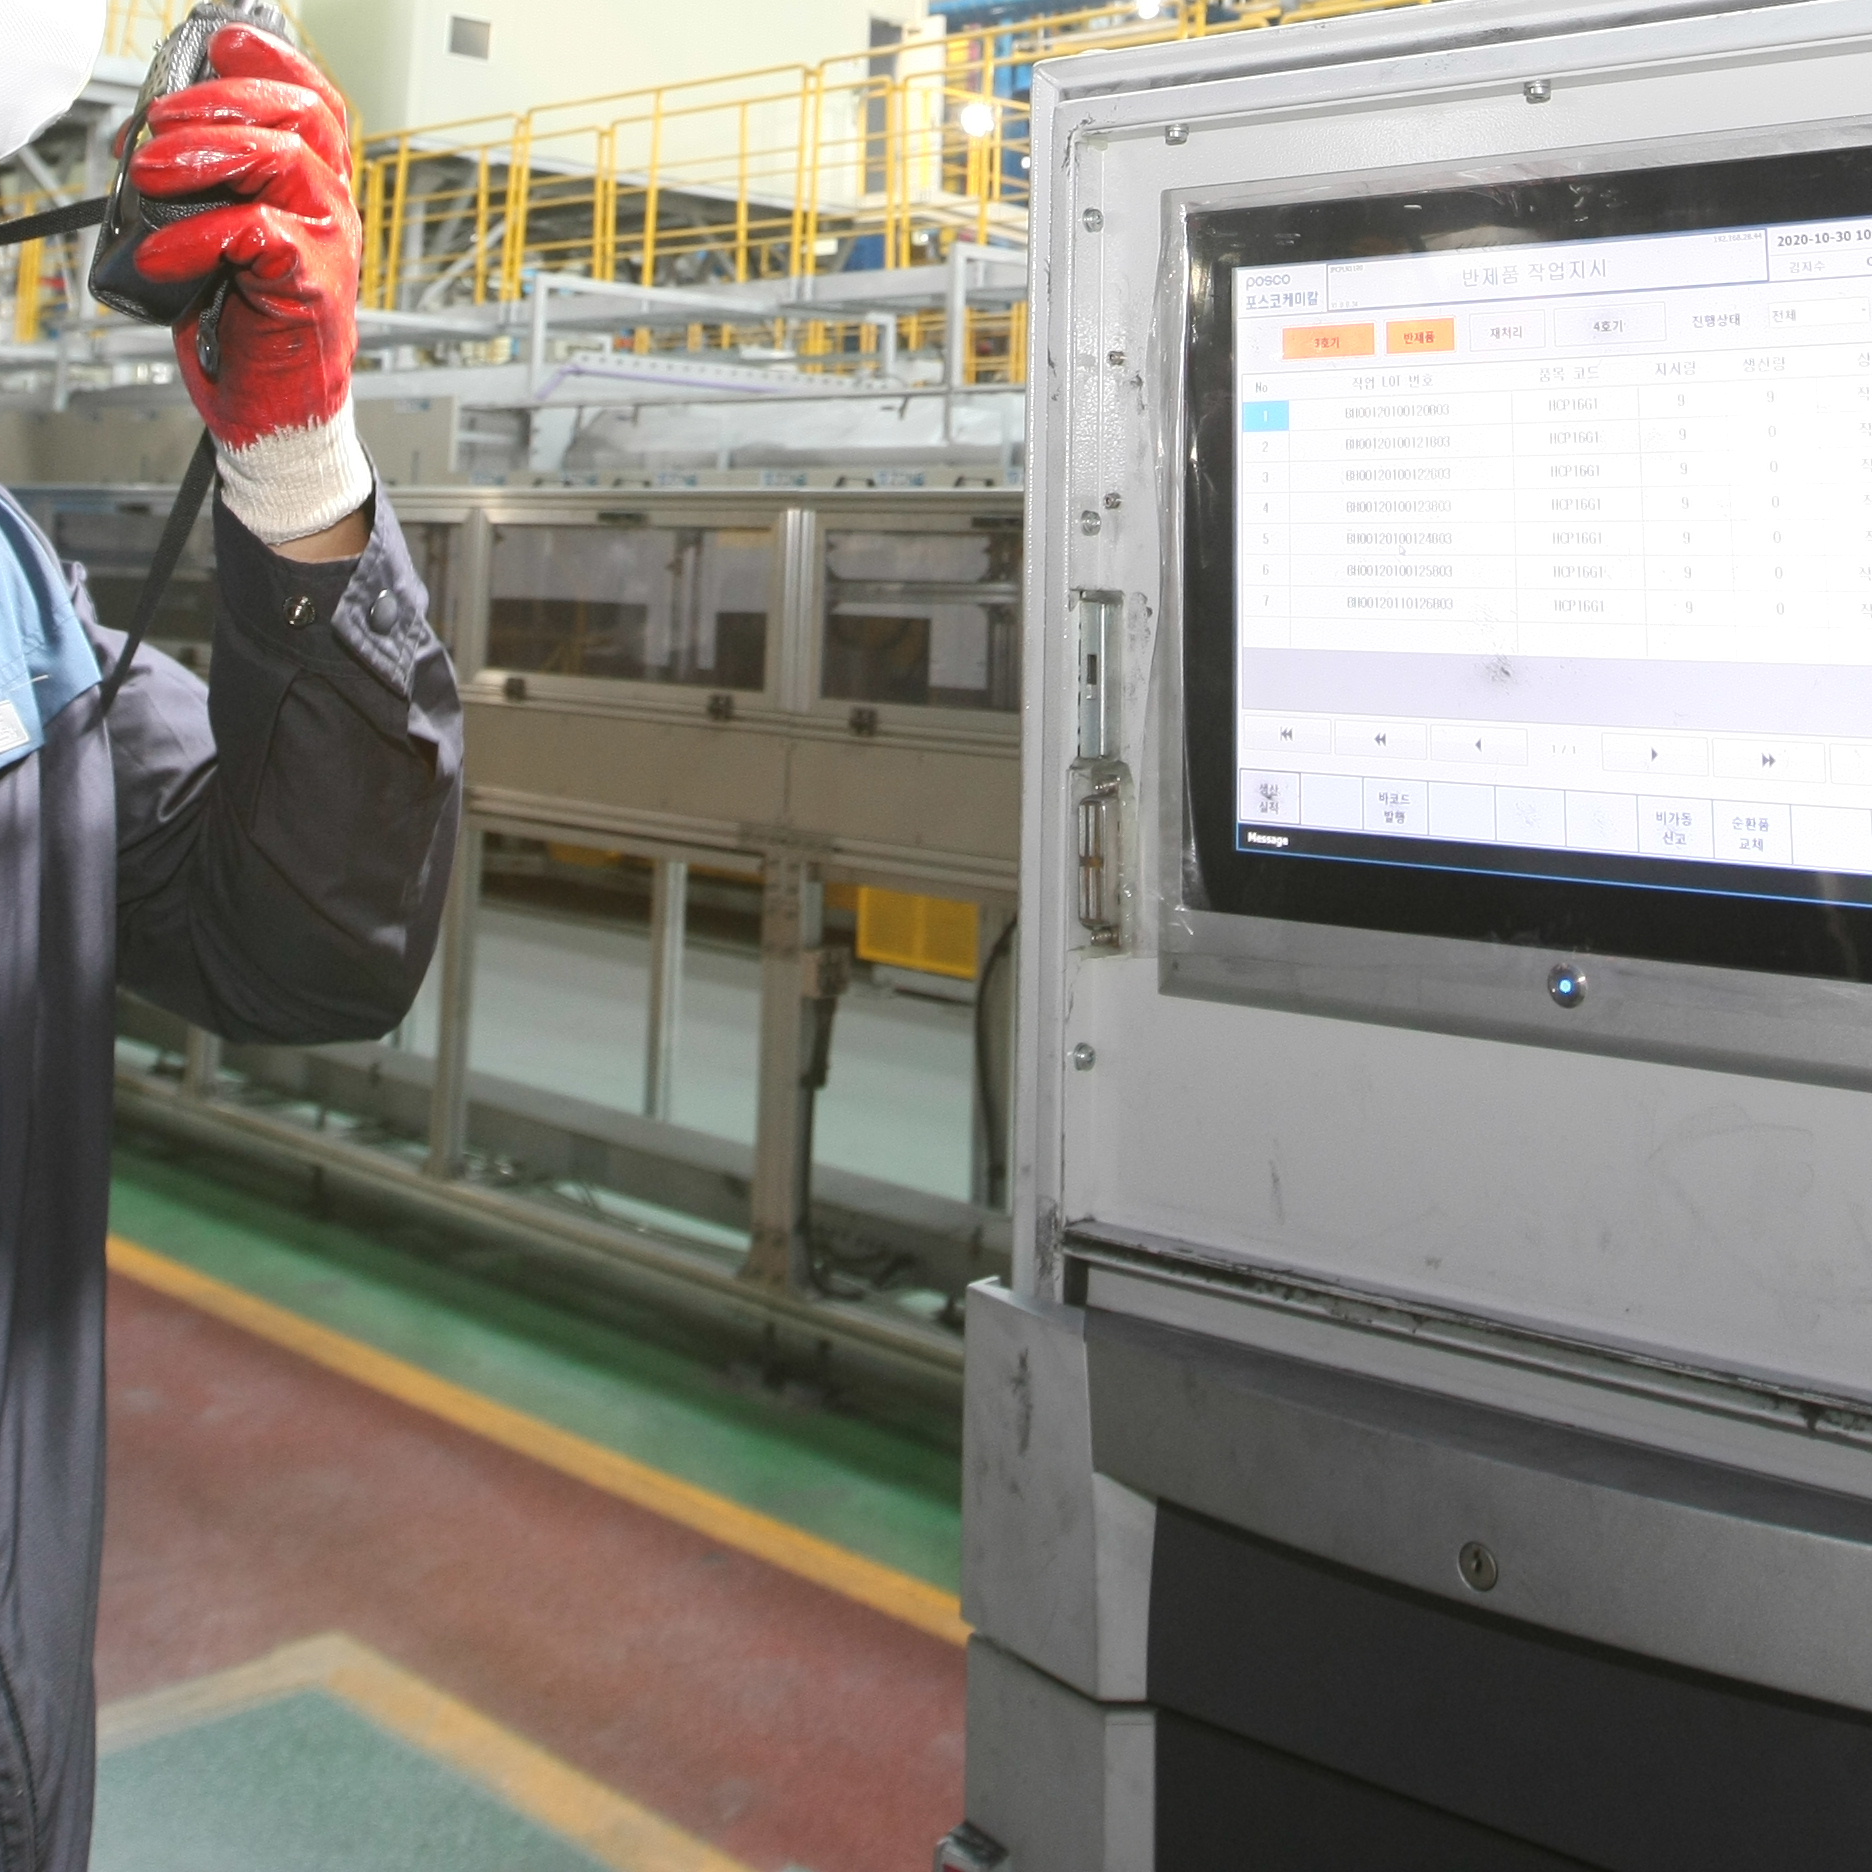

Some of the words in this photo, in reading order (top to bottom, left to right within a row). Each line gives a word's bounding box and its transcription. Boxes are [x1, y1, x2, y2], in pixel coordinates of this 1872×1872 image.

[1777, 229, 1852, 248] 2020-10-30
[1462, 264, 1520, 287] 반제품
[1527, 257, 1607, 283] 작업지시
[1789, 259, 1826, 274] 김지수
[1245, 273, 1291, 291] posco
[1245, 290, 1319, 311] 포스코케미칼
[1692, 313, 1741, 328] 진행상태
[1772, 308, 1797, 322] 전체
[1489, 325, 1523, 340] 재처리
[1592, 319, 1624, 333] 4호기
[1313, 335, 1341, 350] 3호기
[1403, 330, 1436, 345] 반제품
[1539, 367, 1565, 383] 품목
[1573, 364, 1600, 380] 코드
[1655, 361, 1697, 376] 지시량
[1255, 381, 1268, 394] No
[1352, 376, 1376, 391] 작업
[1381, 374, 1401, 389] LOT
[1408, 373, 1434, 388] 번호
[1676, 393, 1686, 408] 9
[1766, 390, 1775, 404] 9
[1548, 398, 1599, 412] HCP16G1
[1262, 409, 1269, 422] 1
[1548, 431, 1600, 445] HCP16G1
[1678, 428, 1687, 442] 9
[1767, 425, 1777, 439] 0
[1261, 440, 1269, 453] 2
[1549, 465, 1601, 478] HCP16G1
[1679, 462, 1688, 476] 9
[1769, 460, 1778, 474] 0
[1261, 471, 1269, 484] 3
[1261, 501, 1270, 515] 4
[1550, 498, 1602, 512] HCP16G1
[1681, 496, 1690, 510] 9
[1770, 495, 1780, 509] 0
[1261, 532, 1270, 546] 5
[1551, 532, 1603, 545] HCP16G1
[1681, 531, 1691, 545] 9
[1772, 530, 1782, 545] 0
[1261, 563, 1270, 577] 6
[1552, 565, 1605, 579] HCP16G1
[1683, 565, 1693, 580] 9
[1774, 566, 1784, 580] 0
[1261, 594, 1270, 607] 7
[1553, 599, 1605, 613] HCP16G1
[1684, 601, 1694, 615] 9
[1776, 602, 1785, 616] 0
[1258, 783, 1280, 796] 생산
[1378, 791, 1411, 805] 바코드
[1258, 801, 1280, 815] 실적
[1383, 810, 1406, 825] 발행
[1655, 810, 1693, 827] 비가동
[1731, 816, 1770, 833] 순환품
[1247, 831, 1289, 848] Message
[1662, 830, 1687, 846] 신고
[1738, 837, 1765, 852] 교체
